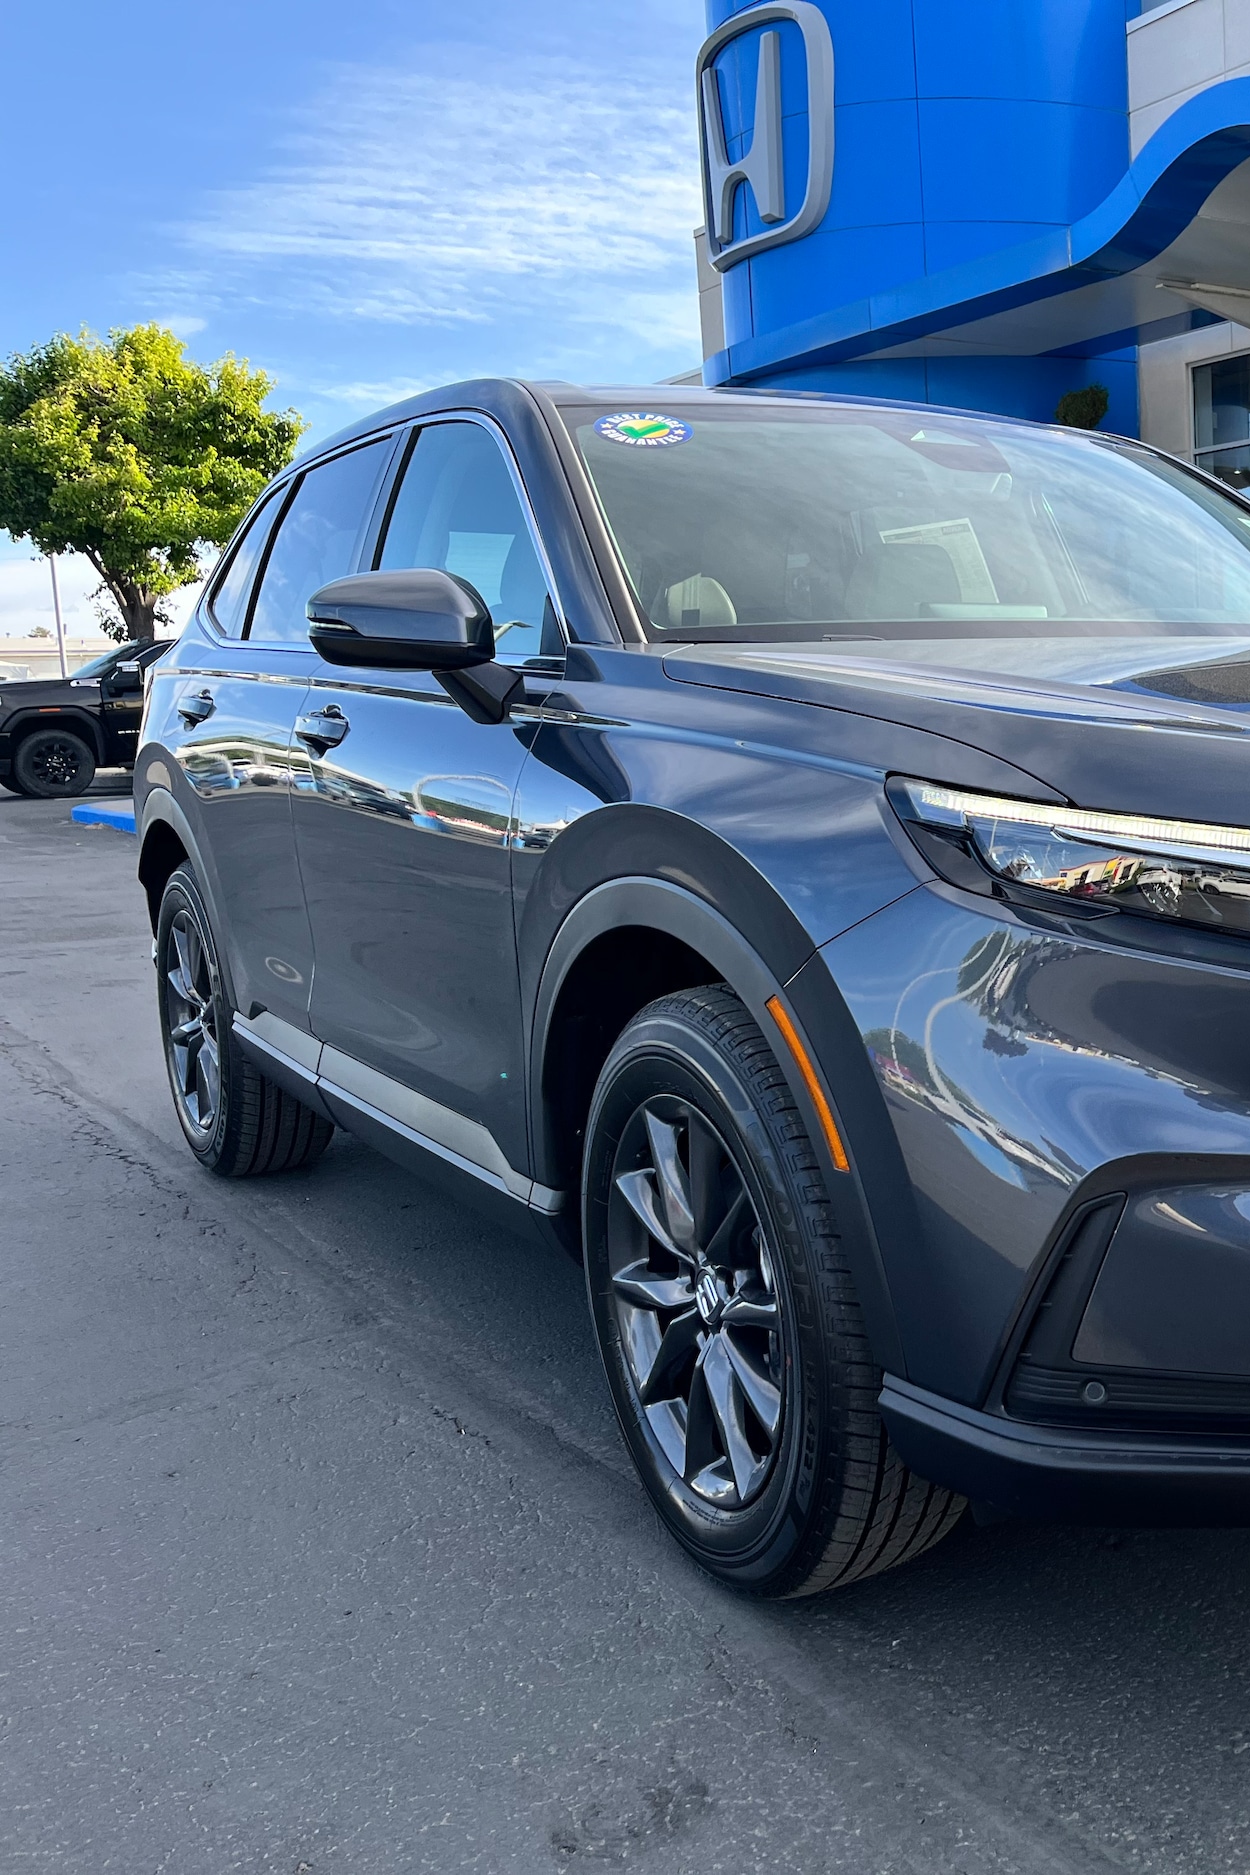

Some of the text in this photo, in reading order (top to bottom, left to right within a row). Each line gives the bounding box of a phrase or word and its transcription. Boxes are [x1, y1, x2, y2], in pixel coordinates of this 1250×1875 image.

[605, 413, 685, 429] BEST PRICE
[601, 429, 683, 446] GUARANTEE
